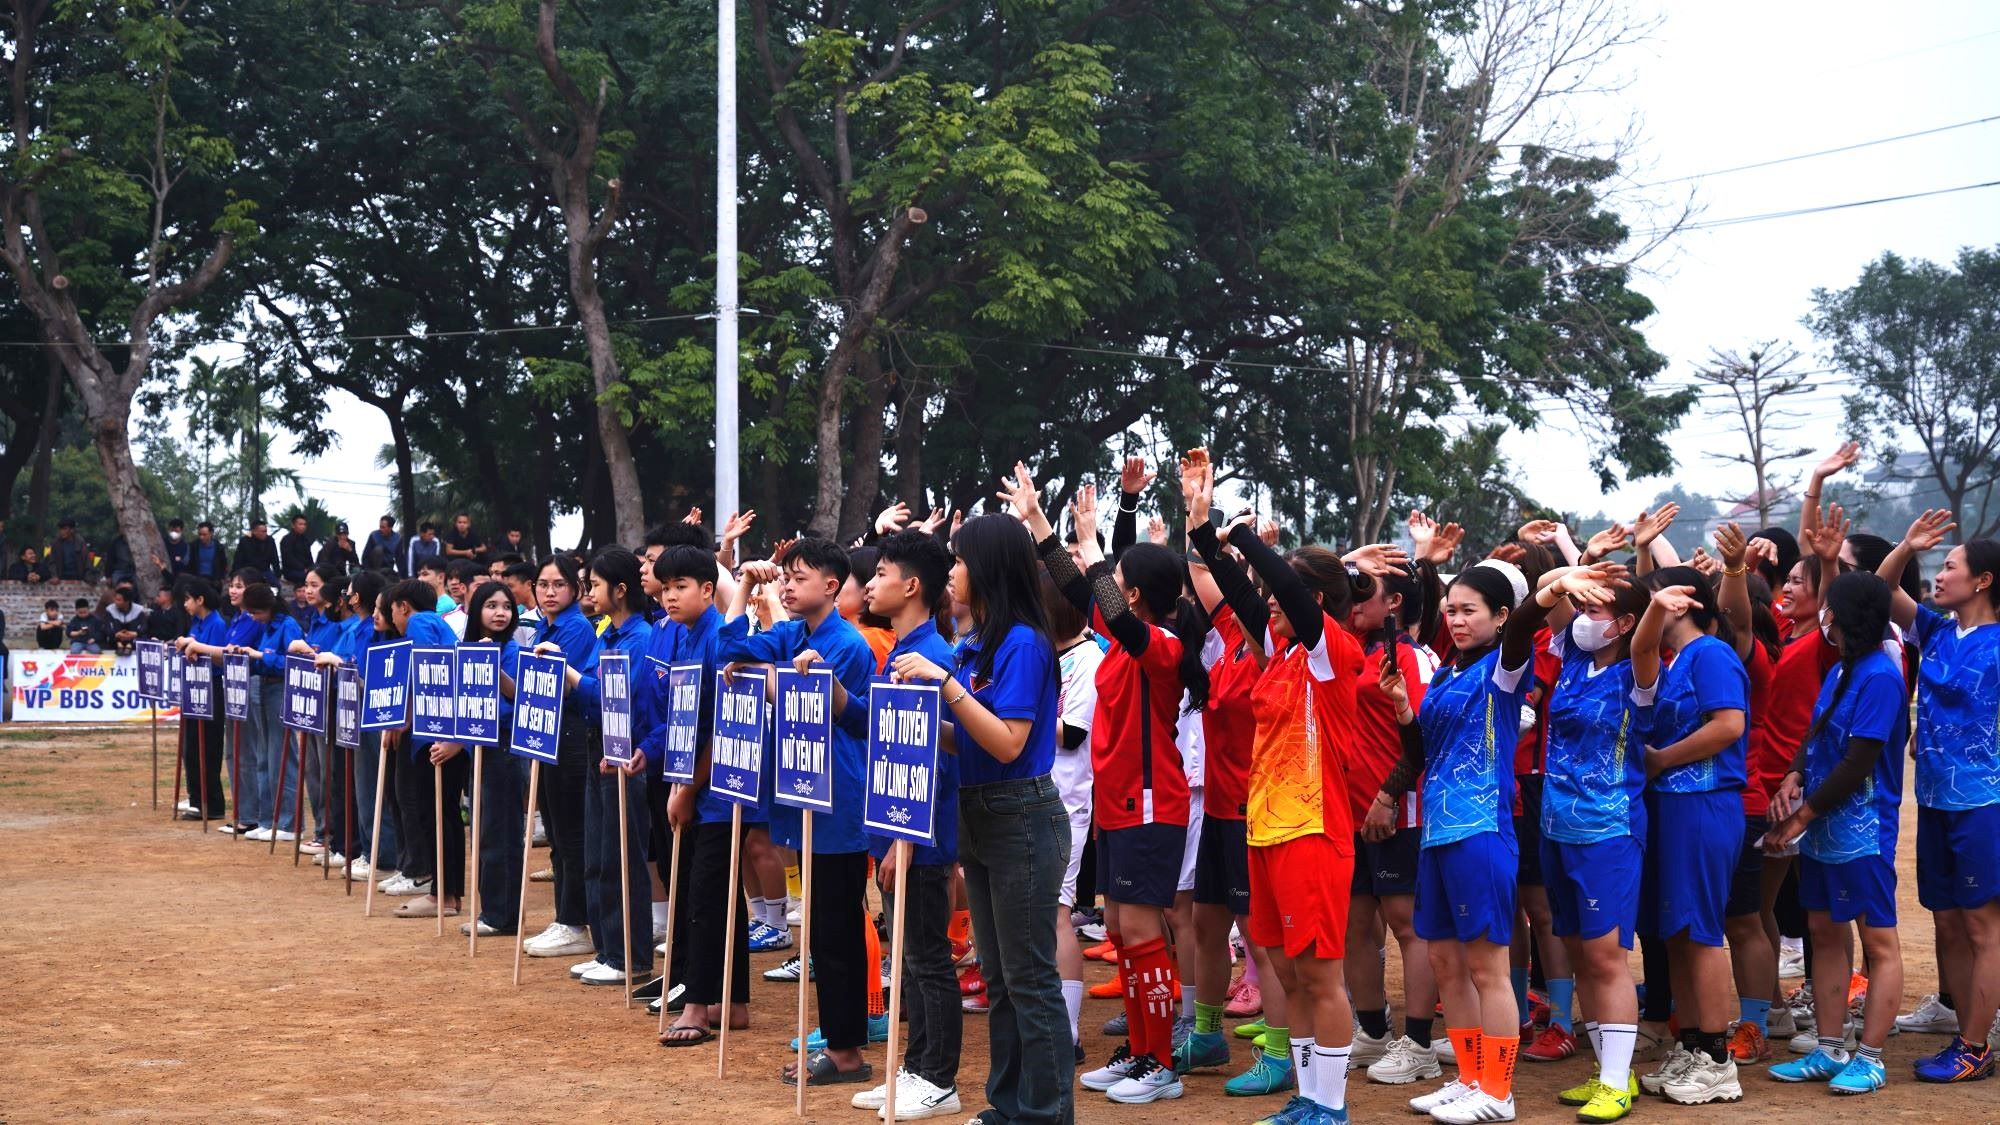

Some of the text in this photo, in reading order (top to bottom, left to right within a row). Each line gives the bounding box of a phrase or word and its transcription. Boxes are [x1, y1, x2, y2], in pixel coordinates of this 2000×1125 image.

[80, 664, 105, 676] NHÀ
[110, 664, 130, 676] TÀI
[289, 666, 322, 692] ĐỘI TUYỂN
[384, 650, 395, 678] TỔ
[418, 656, 449, 689] ĐỘI TUYỂN
[463, 654, 494, 689] ĐỘI TUYỂN
[523, 664, 557, 698] ĐỘI TUYỂN
[24, 689, 52, 709] VP
[60, 689, 104, 709] BĐS
[369, 682, 404, 712] TRỌNG TÀI
[605, 663, 627, 703] ĐỘI TUYỂN
[673, 673, 696, 717] ĐỘI TUYỂN
[416, 691, 426, 716] NỮ
[426, 691, 439, 717] THÁI
[458, 691, 496, 721] NỮ PHÚC TIẾN
[517, 700, 557, 735] NỮ SEN TRÌ
[722, 683, 758, 727] ĐỘI TUYỂN
[785, 680, 824, 729] ĐỘI TUYỂN
[668, 720, 677, 751] NỮ
[878, 696, 929, 750] ĐỘI TUYỂN
[713, 730, 722, 764] NỮ
[782, 733, 825, 774] NỮ YÊN MỸ
[873, 755, 929, 803] NỮ LINH SƠN
